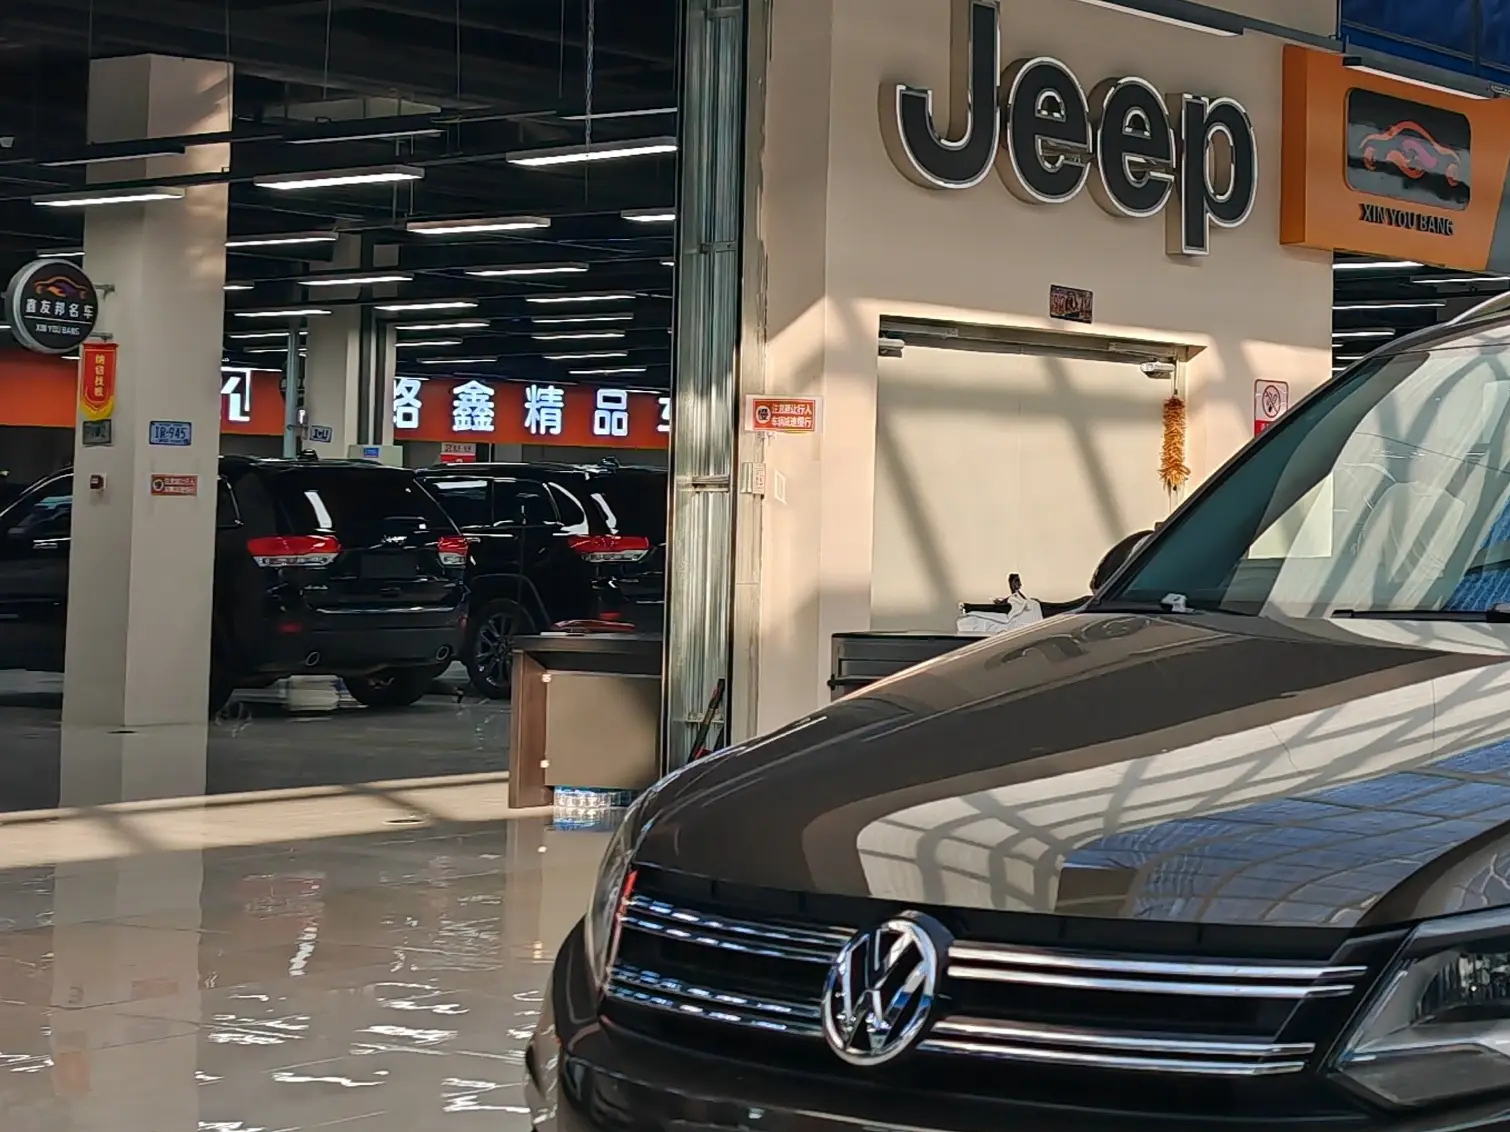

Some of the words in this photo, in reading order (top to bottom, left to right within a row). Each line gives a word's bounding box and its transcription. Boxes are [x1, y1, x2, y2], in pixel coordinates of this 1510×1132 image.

[884, 0, 1259, 256] Jeep
[1361, 203, 1385, 224] XIN
[1387, 208, 1416, 229] YOU
[26, 299, 94, 319] 鑫友邦名车
